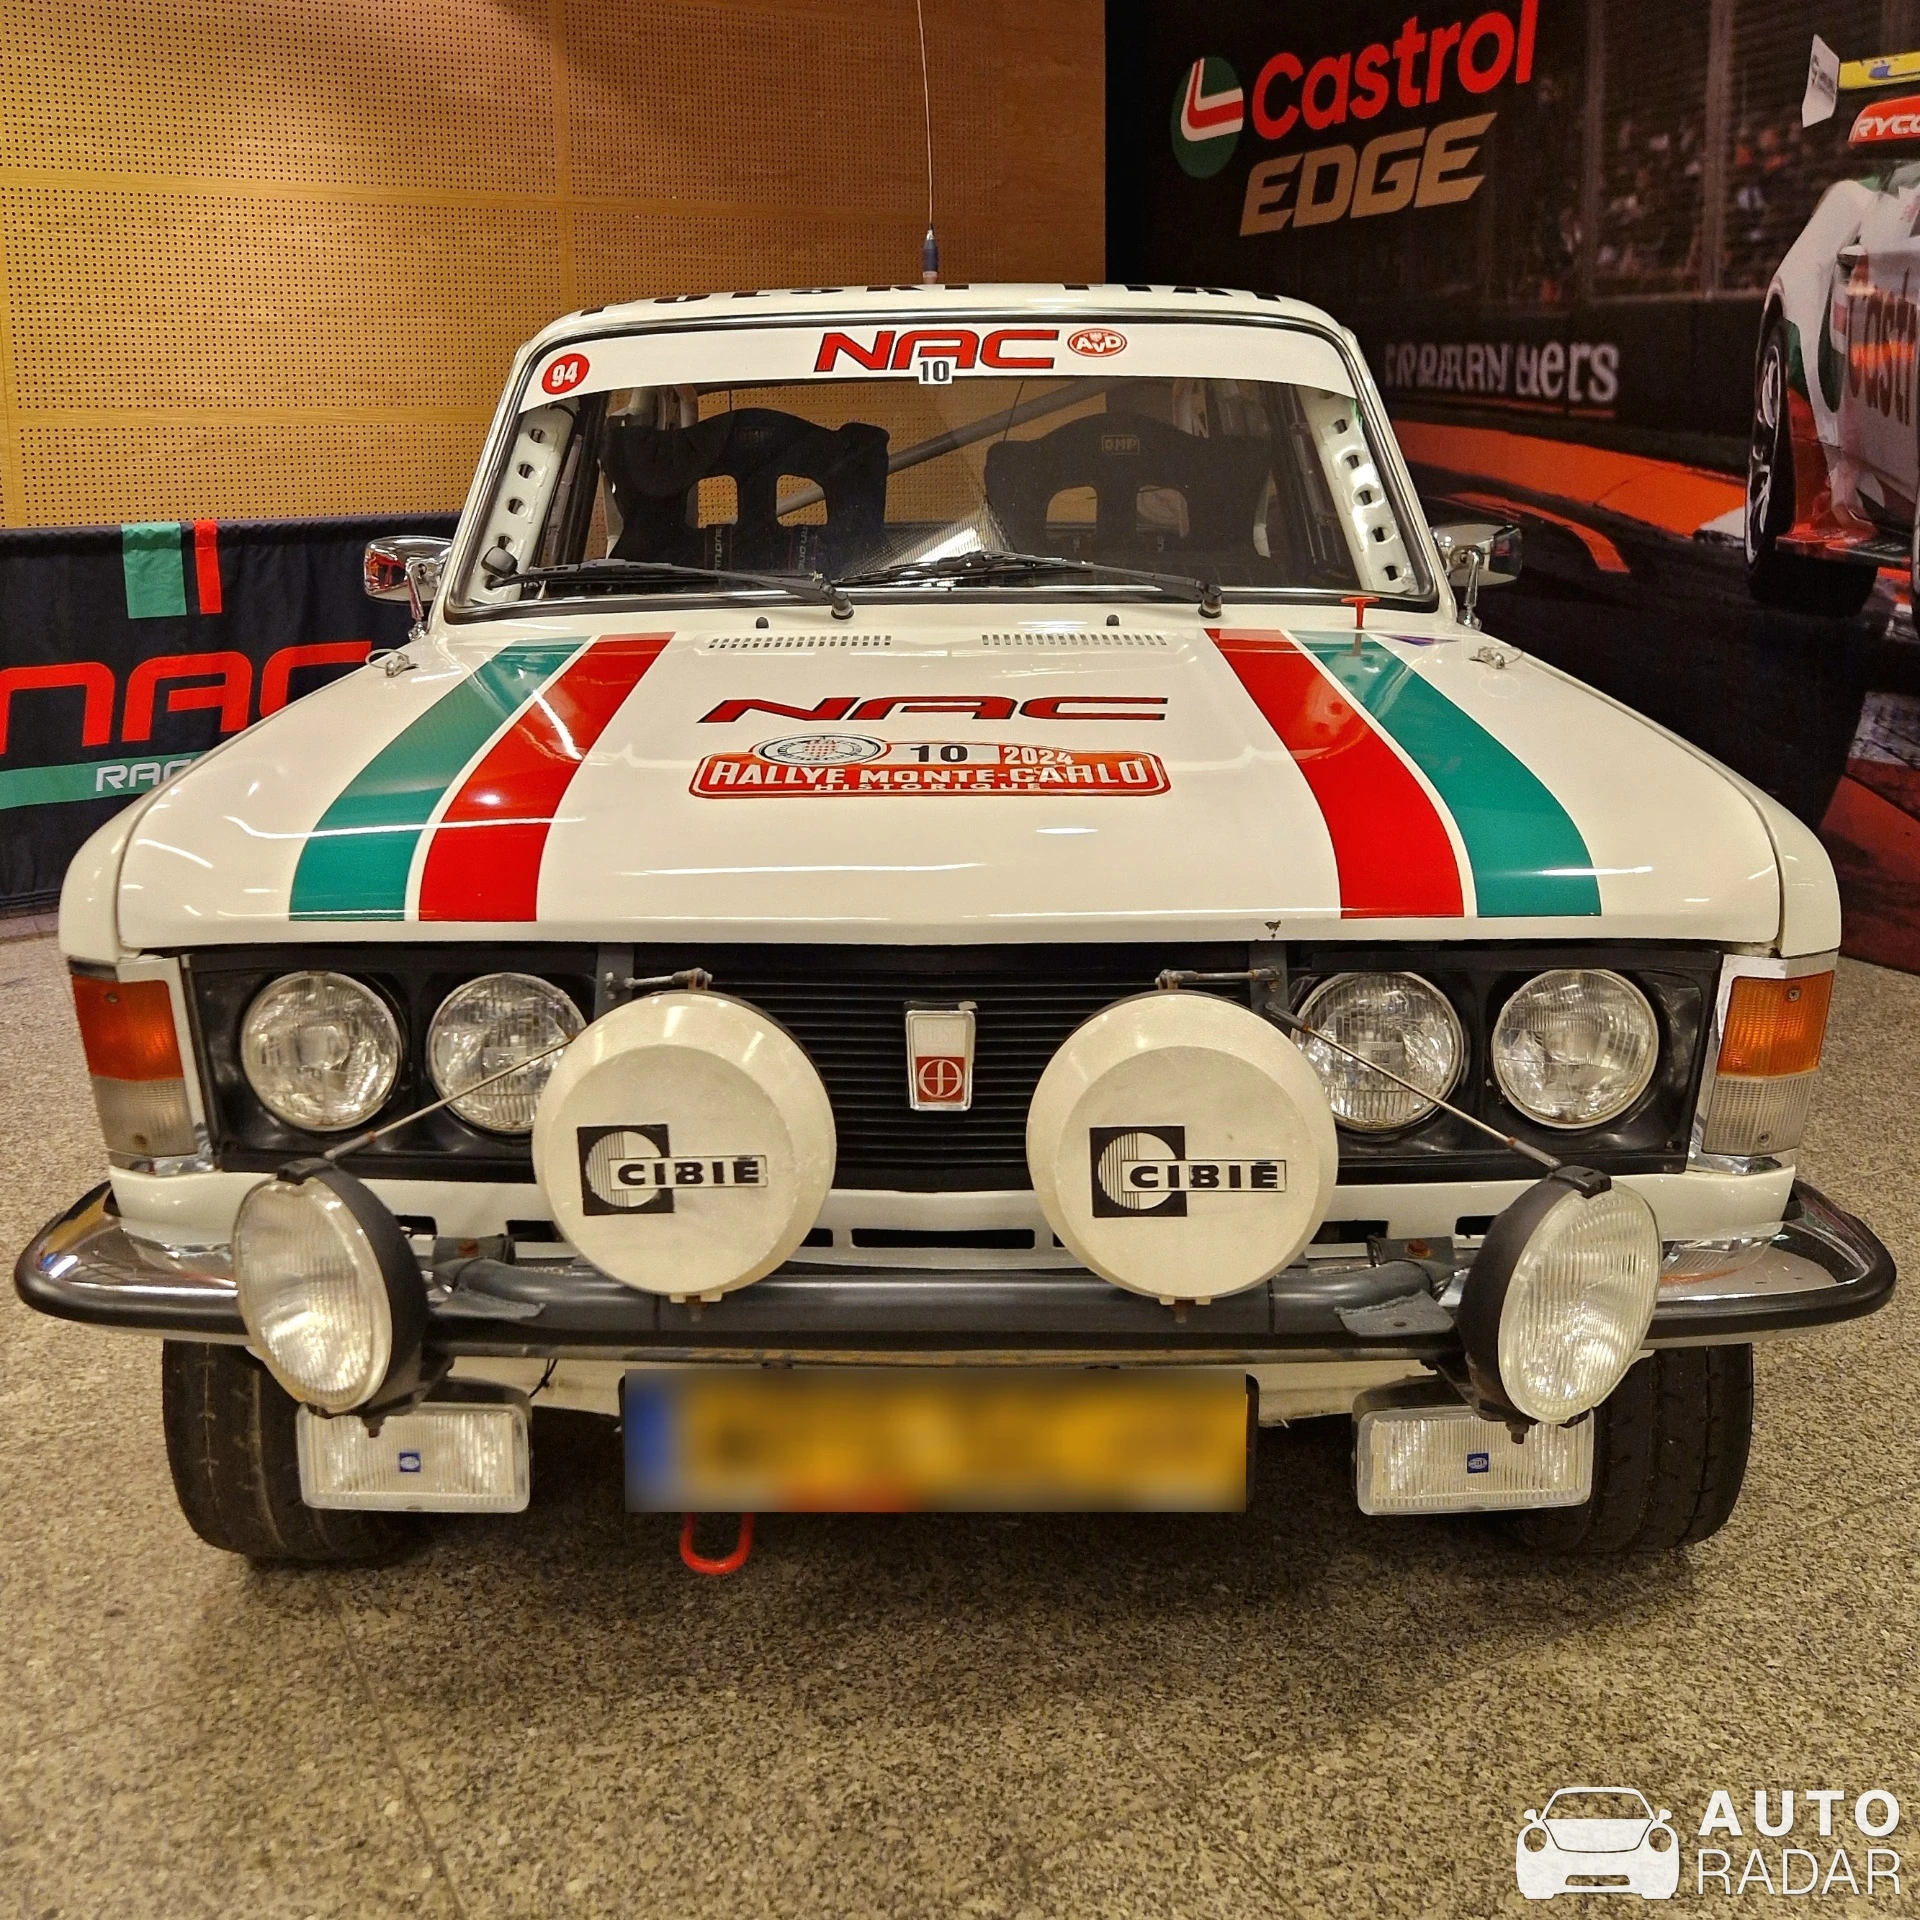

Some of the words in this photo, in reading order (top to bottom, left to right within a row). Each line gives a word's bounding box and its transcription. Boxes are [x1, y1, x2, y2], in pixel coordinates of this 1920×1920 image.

[1252, 0, 1539, 140] Castrol
[1239, 111, 1498, 236] EDGE
[813, 329, 1060, 372] NAC
[551, 360, 579, 388] 94
[919, 360, 950, 382] 10
[695, 696, 1168, 723] NAC
[910, 744, 968, 763] 10
[1003, 746, 1074, 765] 2024
[708, 761, 845, 785] RALLYE
[858, 761, 1149, 785] MONTE-CARLO
[814, 782, 1041, 791] HISTORIQUE
